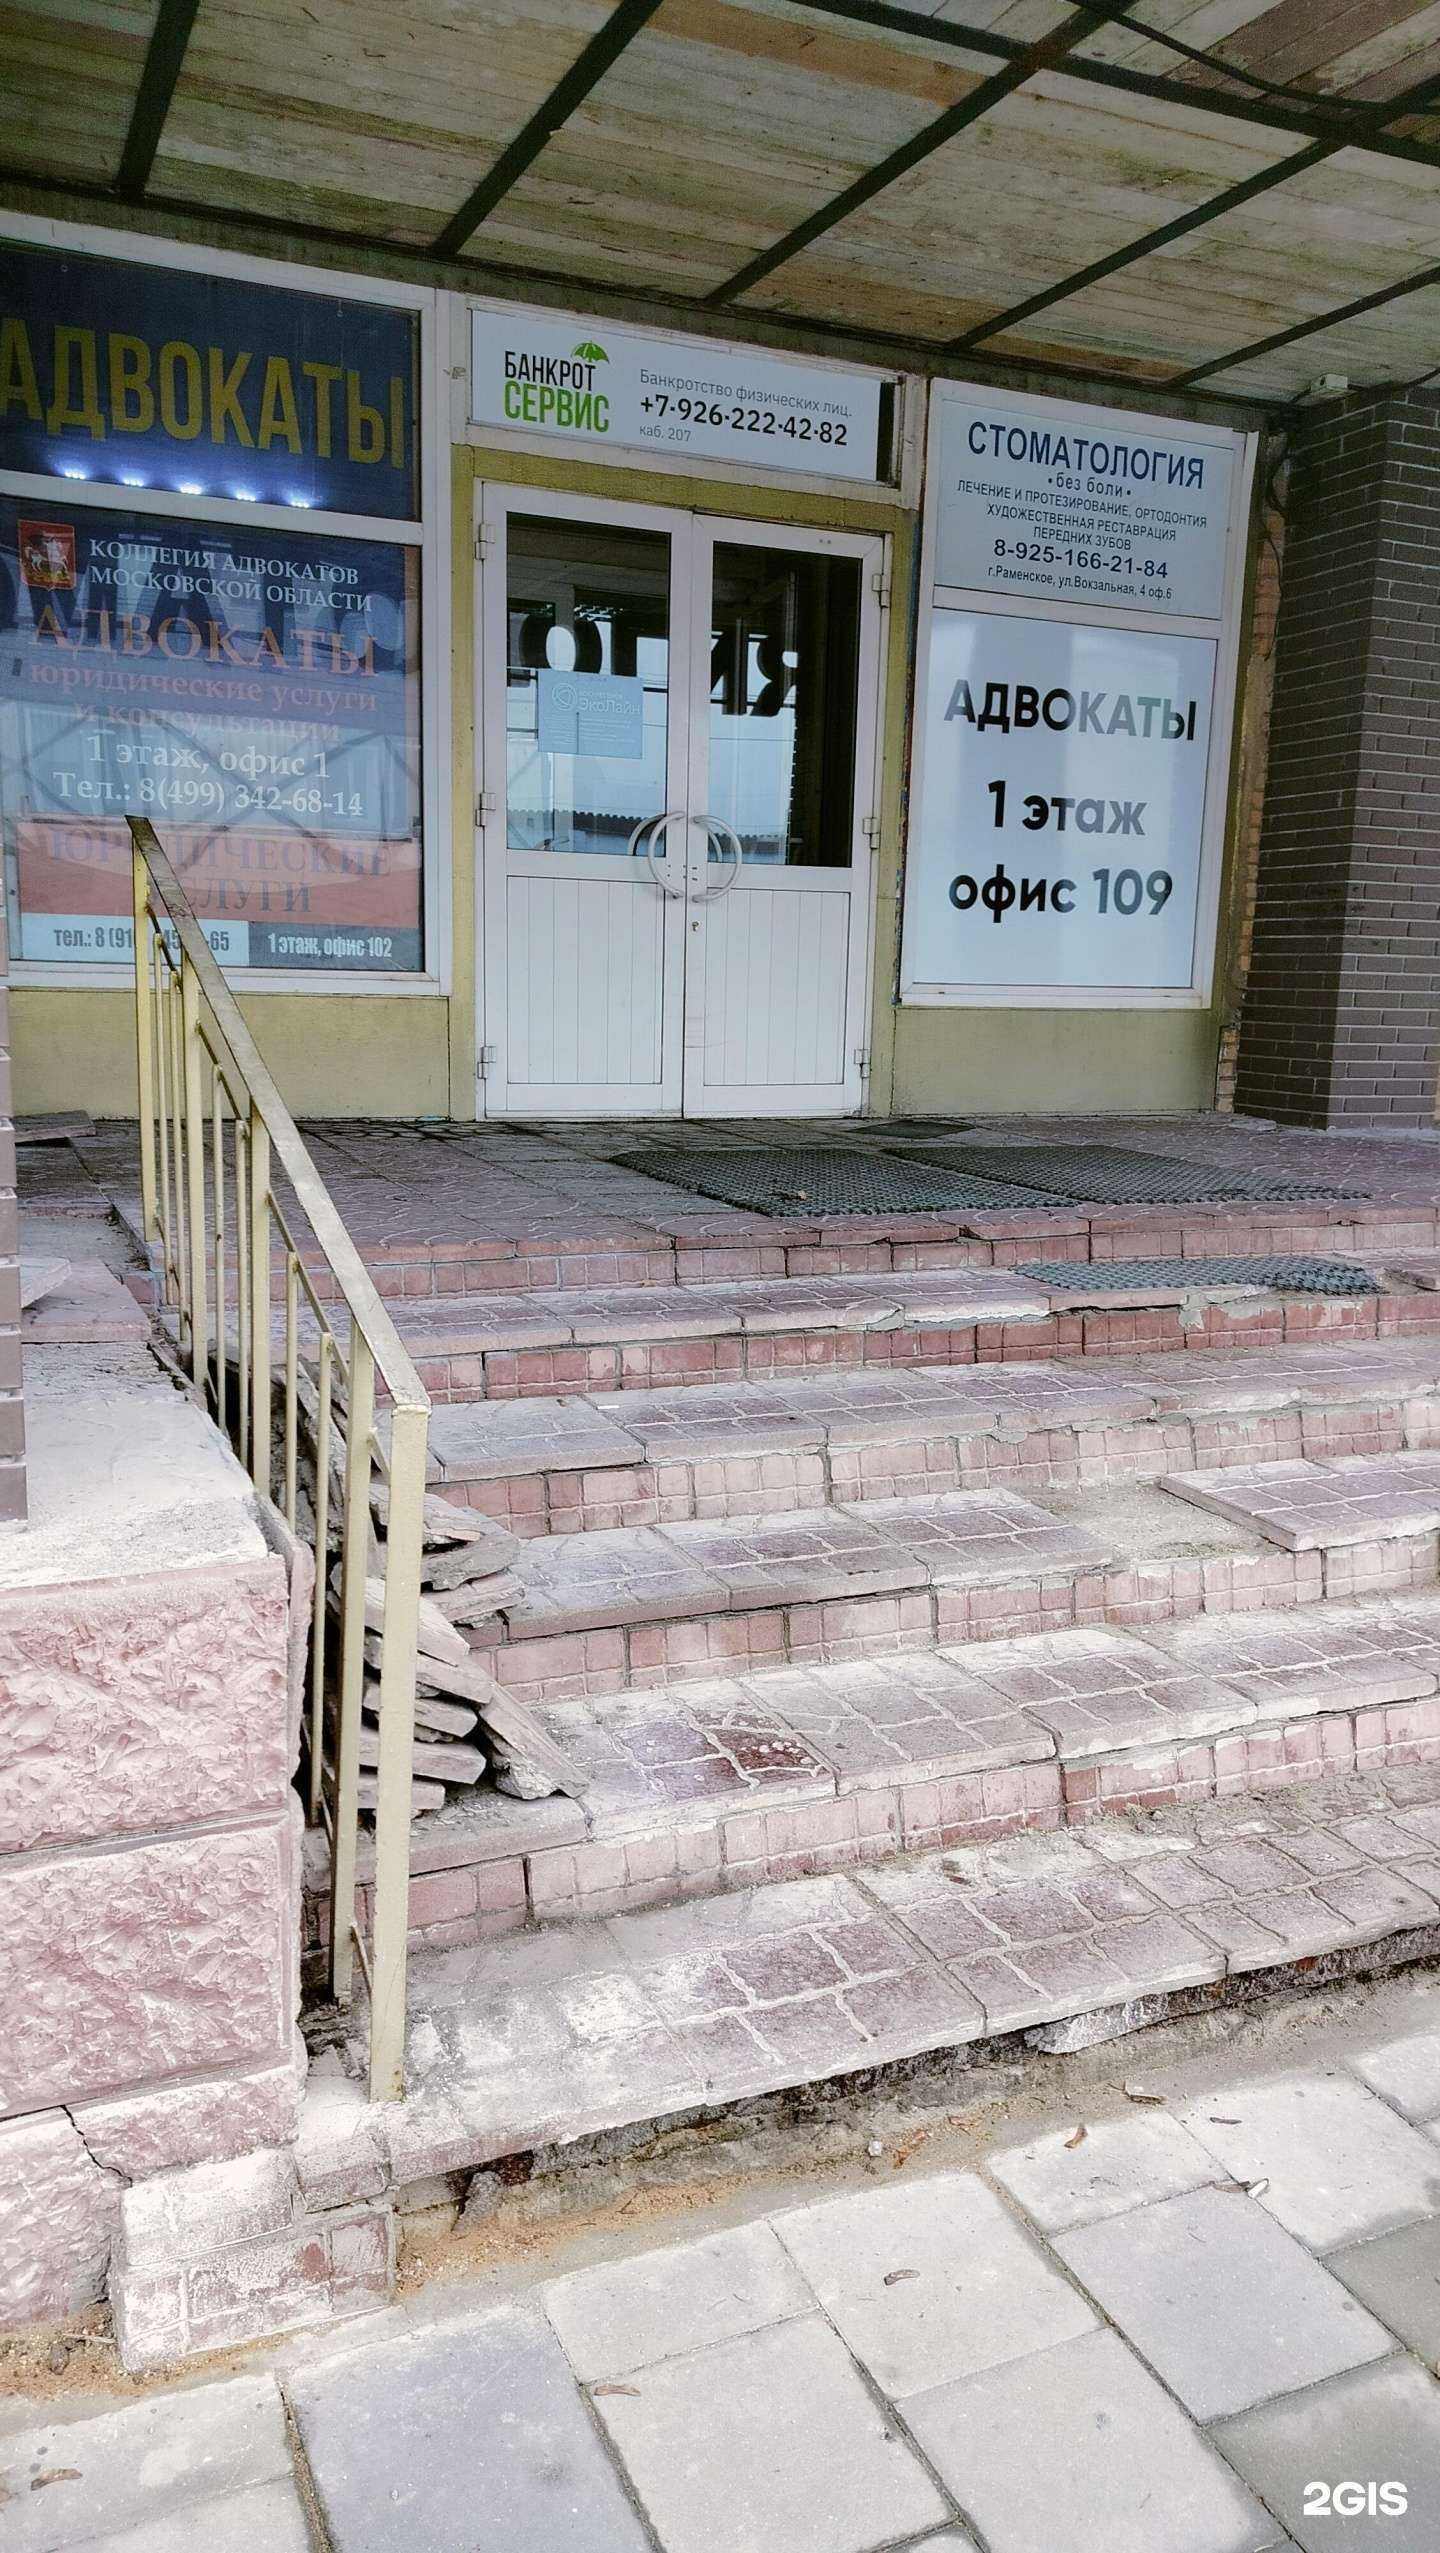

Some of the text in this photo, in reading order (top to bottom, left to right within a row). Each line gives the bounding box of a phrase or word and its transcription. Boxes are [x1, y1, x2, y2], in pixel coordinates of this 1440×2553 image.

[0, 318, 404, 469] АДВОКАТЫ
[504, 350, 597, 392] БАНКРОТ
[640, 368, 853, 418] Банкротство физических лиц.
[503, 379, 610, 433] СЕРВИС
[639, 424, 692, 442] каб. 207
[968, 421, 1205, 489] СТОМАТОЛОГИЯ
[957, 479, 1207, 528] ЛЕЧЕНИЕ И ПРОТЕЗИРОВАНИЕ, ОРТОДОНТИЯ
[1056, 471, 1123, 498] без боли
[987, 503, 1177, 541] ХУДОЖЕСТВЕННАЯ РЕСТАВРАЦИЯ
[1033, 526, 1132, 551] ПЕРЕДНИХ ЗУБОВ
[89, 539, 360, 586] КОЛЛЕГИЯ АДВОКАТОВ
[993, 538, 1168, 579] 8-925-166-21-84
[90, 565, 373, 614] МОСКОВСКОЙ ОБЛАСТИ
[1139, 583, 1146, 597] 4
[32, 603, 380, 679] АДВОКАТЫ
[30, 664, 378, 718] юридические услуги
[943, 678, 1197, 742] АДВОКАТЫ
[87, 735, 331, 782] 1 этаж, офис 1
[52, 771, 363, 817] Тел.: 8(499) 342-68-14
[988, 780, 1148, 836] 1 этаж
[949, 864, 1173, 923] офис 109
[53, 927, 93, 949] тел.:
[95, 926, 105, 949] 8
[268, 933, 393, 958] 1 этаж, офис 102
